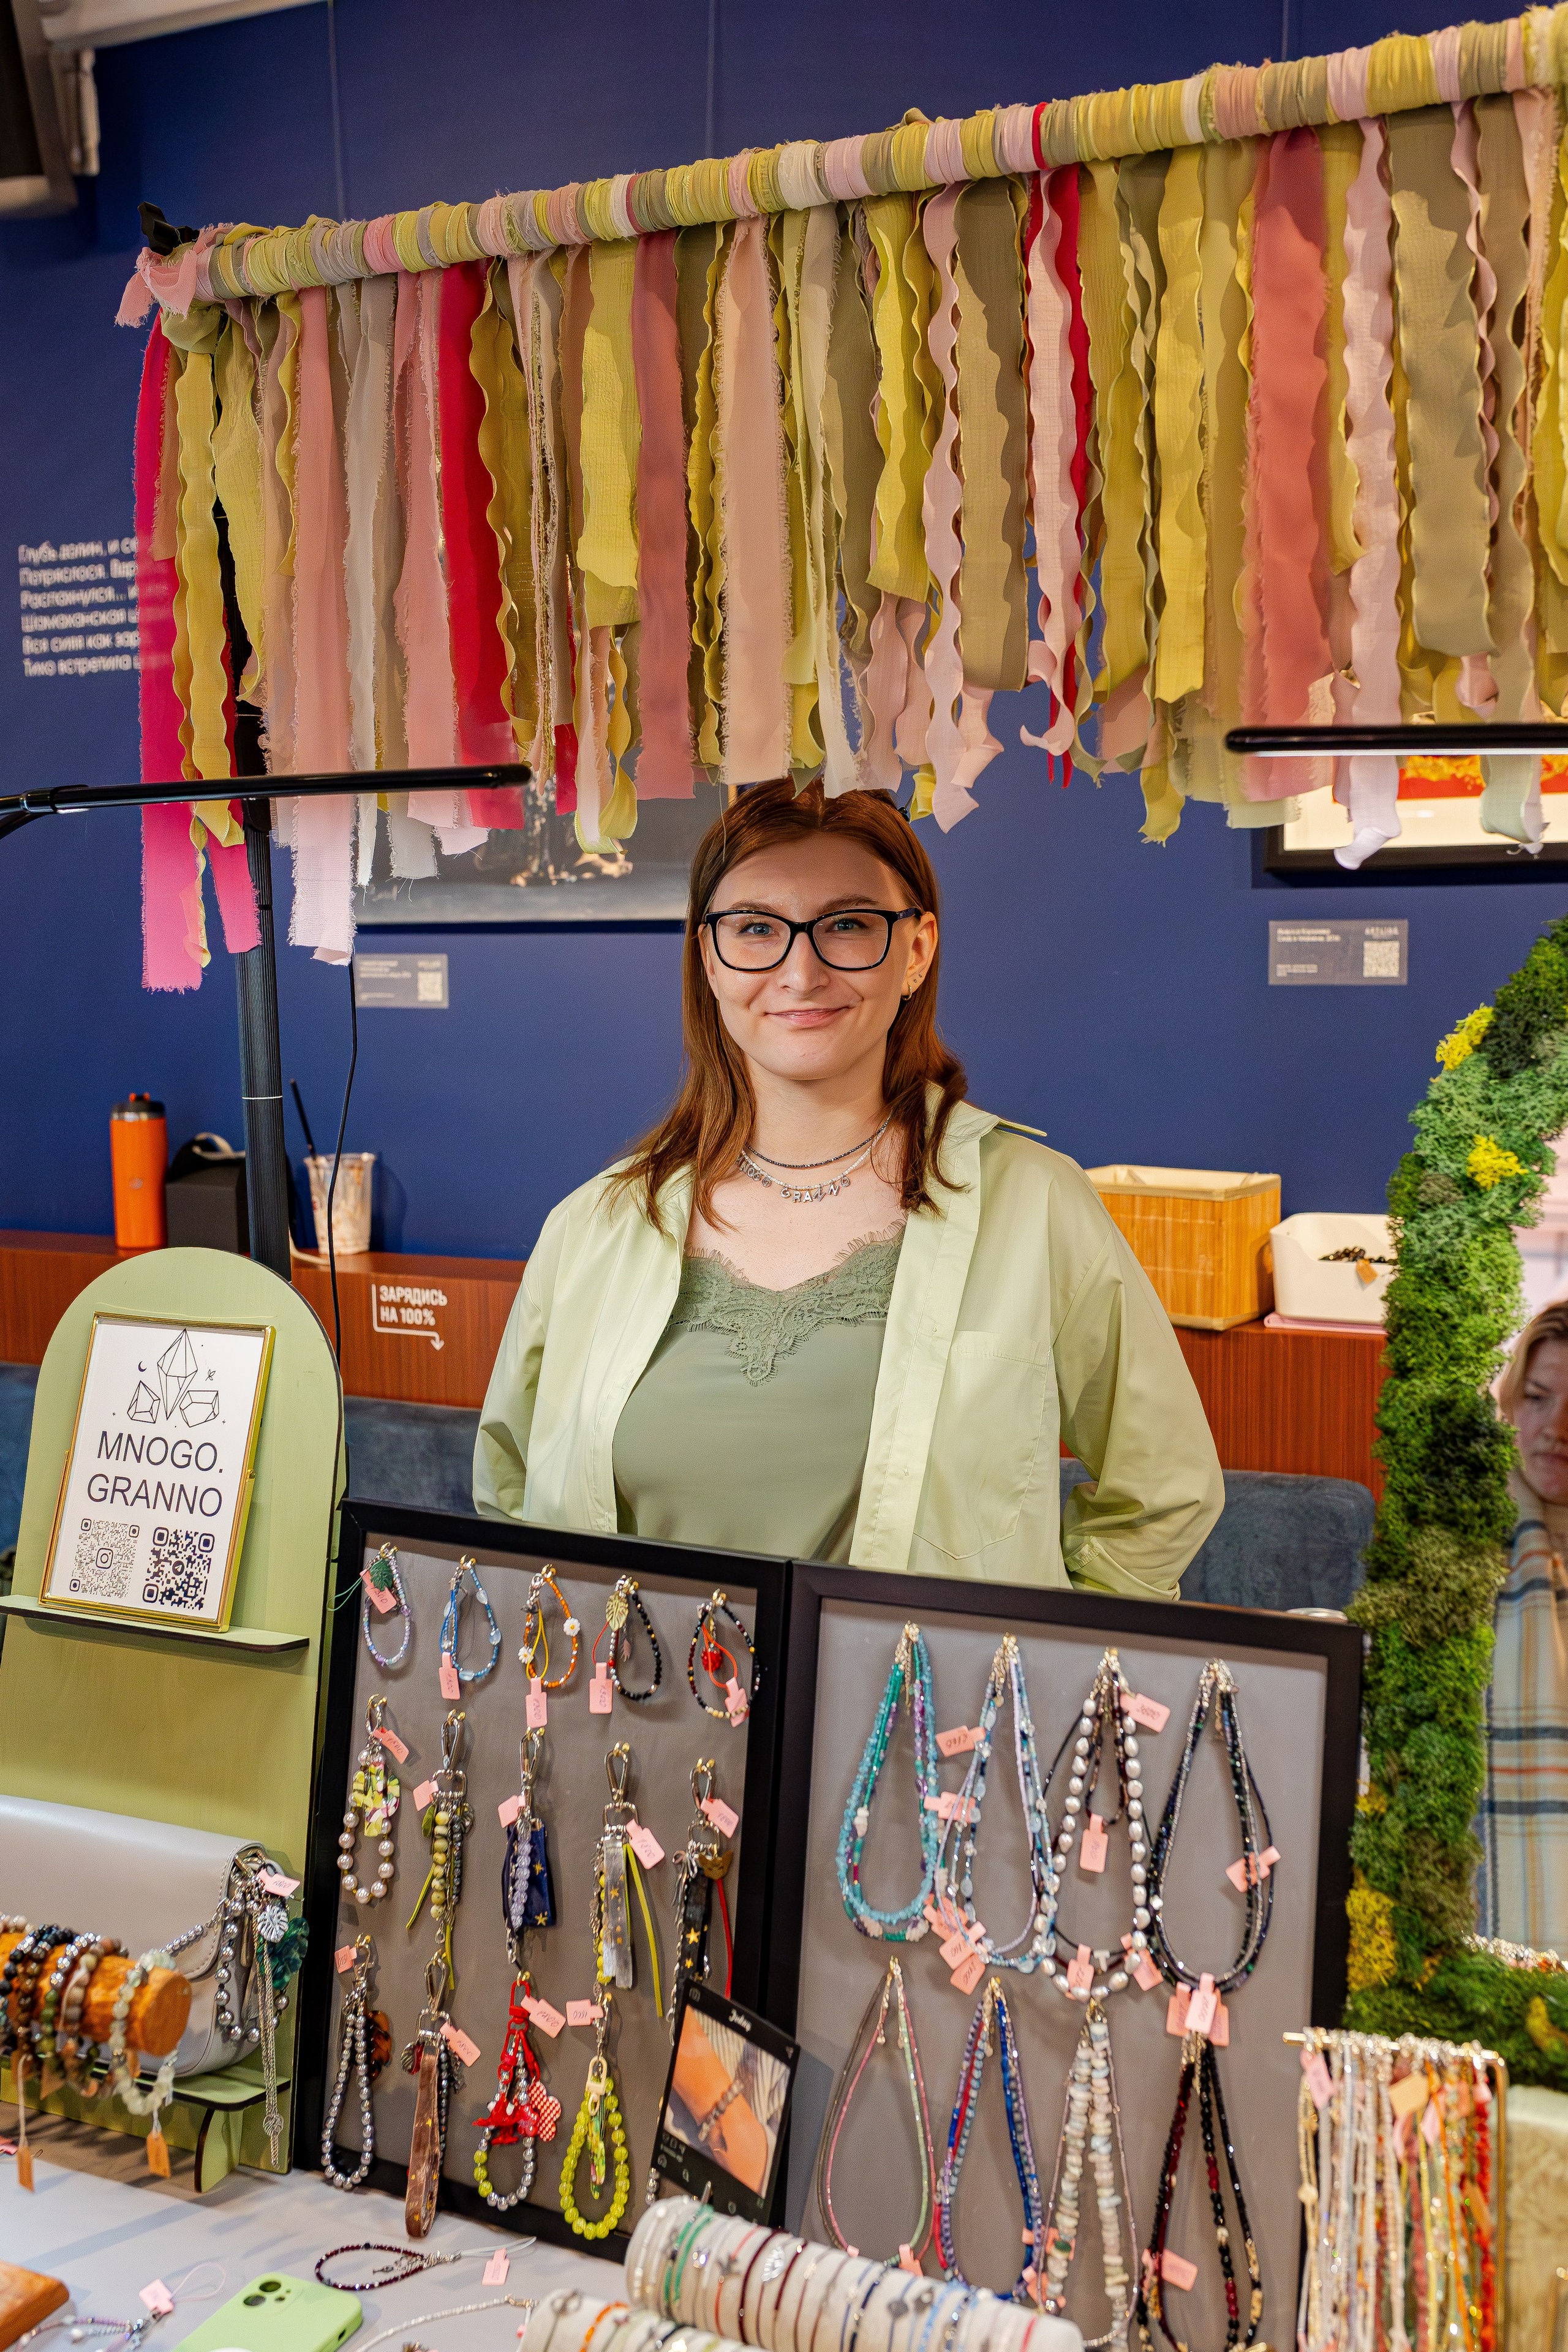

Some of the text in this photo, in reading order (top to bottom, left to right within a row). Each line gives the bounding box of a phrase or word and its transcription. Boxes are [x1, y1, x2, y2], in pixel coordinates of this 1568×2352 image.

[780, 1175, 851, 1202] GRANNO
[380, 1285, 448, 1306] ЗАРЯДИСЬ
[380, 1306, 435, 1326] НА 100%
[97, 1430, 224, 1473] MNOGO.
[87, 1474, 222, 1517] GRANNO
